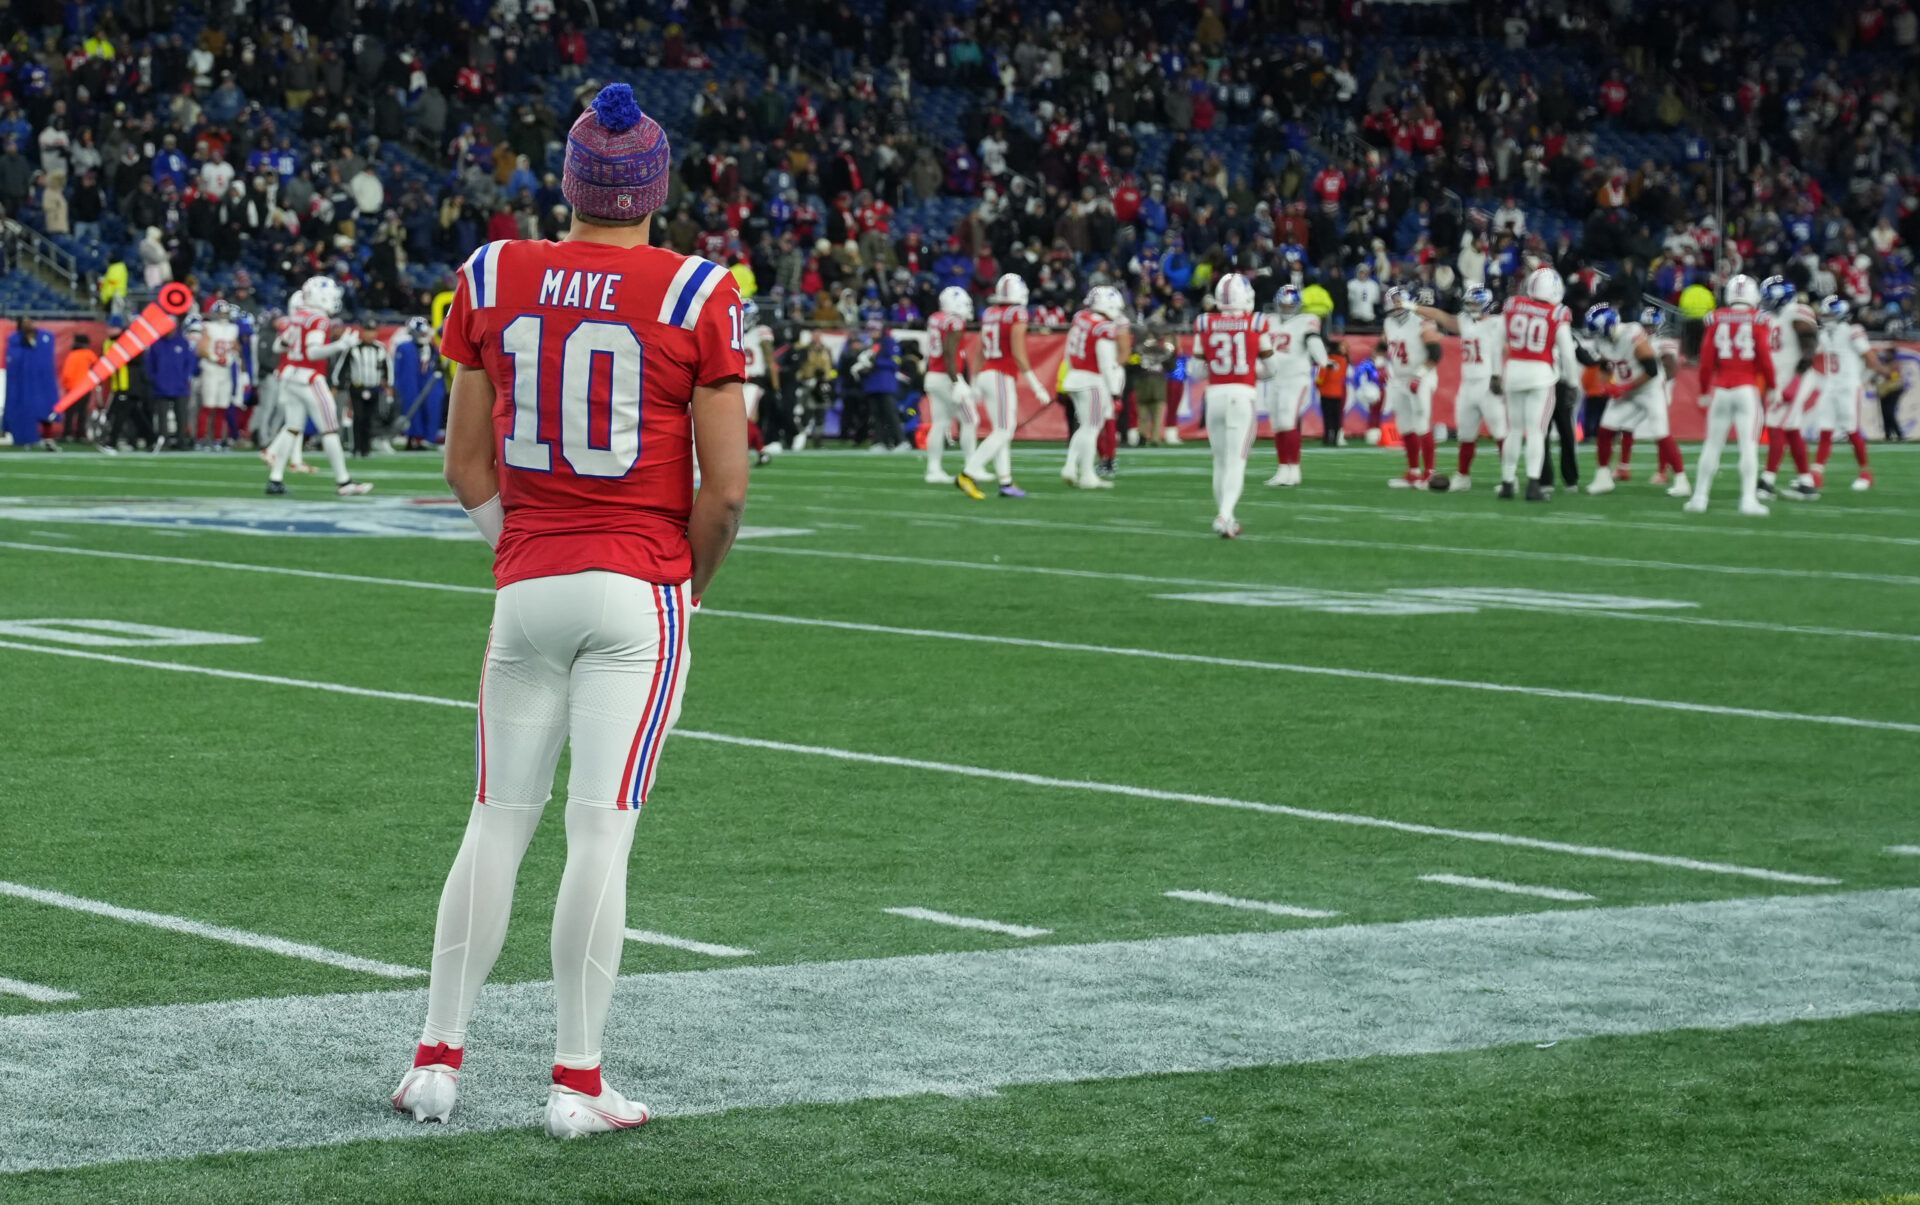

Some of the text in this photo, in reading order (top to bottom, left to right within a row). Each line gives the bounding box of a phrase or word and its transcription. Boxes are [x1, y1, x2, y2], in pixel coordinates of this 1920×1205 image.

[539, 268, 622, 312] MAYE
[1208, 331, 1250, 376] 31
[1509, 313, 1550, 353] 90
[1713, 321, 1756, 361] 44
[502, 313, 644, 479] 10
